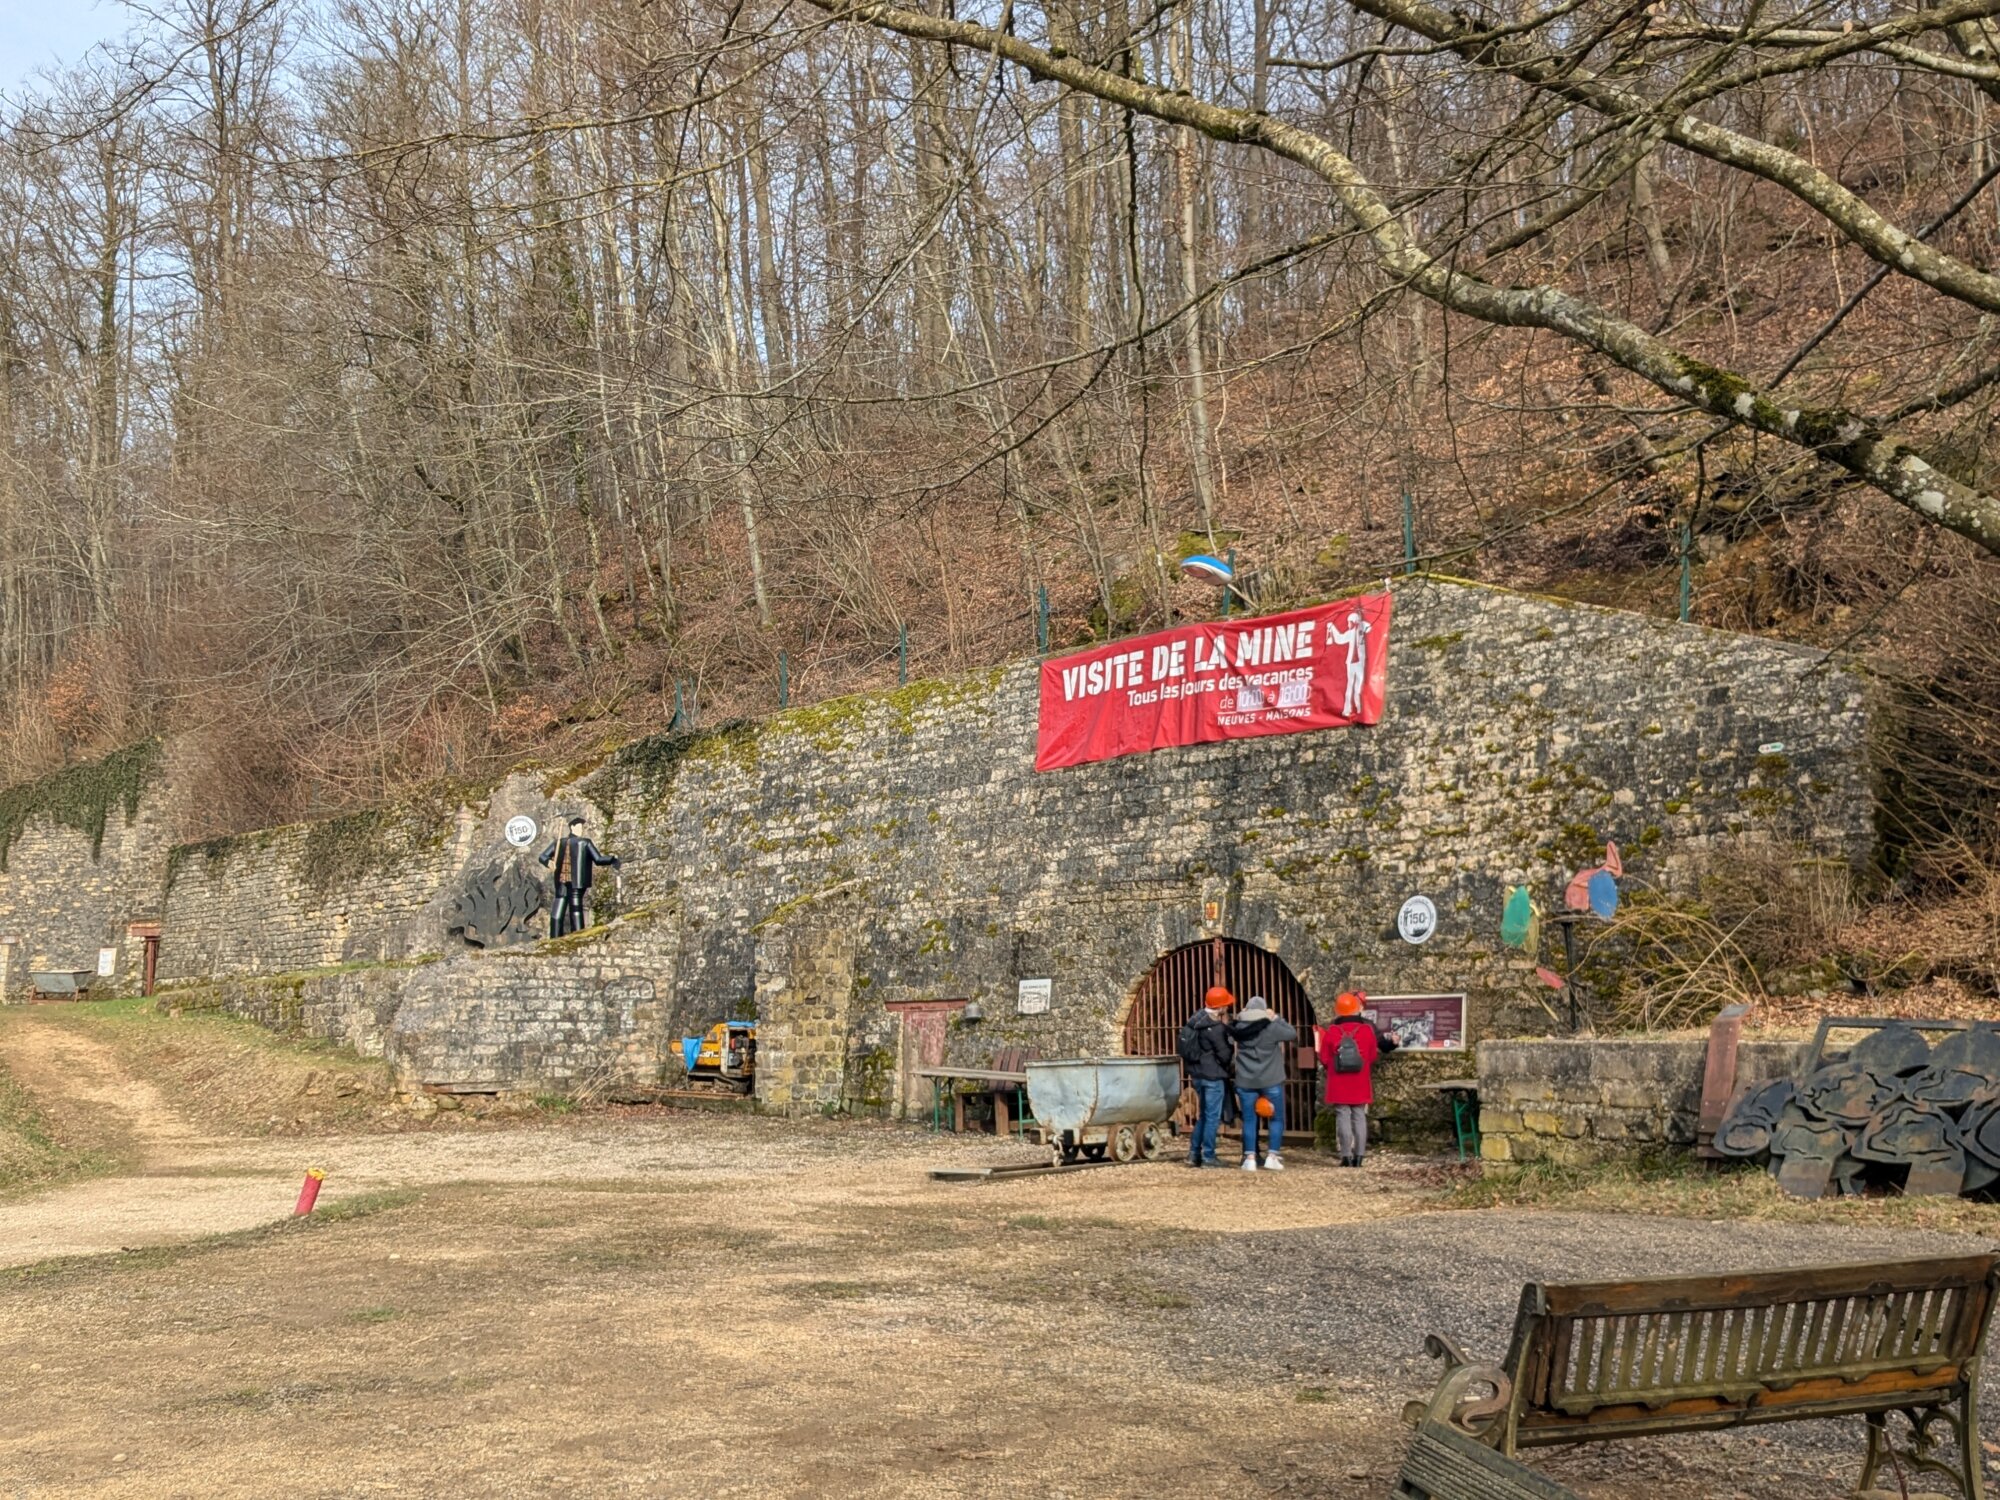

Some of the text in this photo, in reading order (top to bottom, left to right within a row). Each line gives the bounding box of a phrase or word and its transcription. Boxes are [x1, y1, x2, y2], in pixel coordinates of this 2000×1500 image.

[1062, 621, 1315, 701] VISITE DE LA MINE
[1127, 666, 1314, 707] Tous les jours des vacances
[1219, 695, 1234, 709] de
[1267, 690, 1276, 703] à
[1217, 713, 1256, 726] NEUVES
[1266, 707, 1311, 721] MAISONS
[1409, 911, 1425, 925] 150
